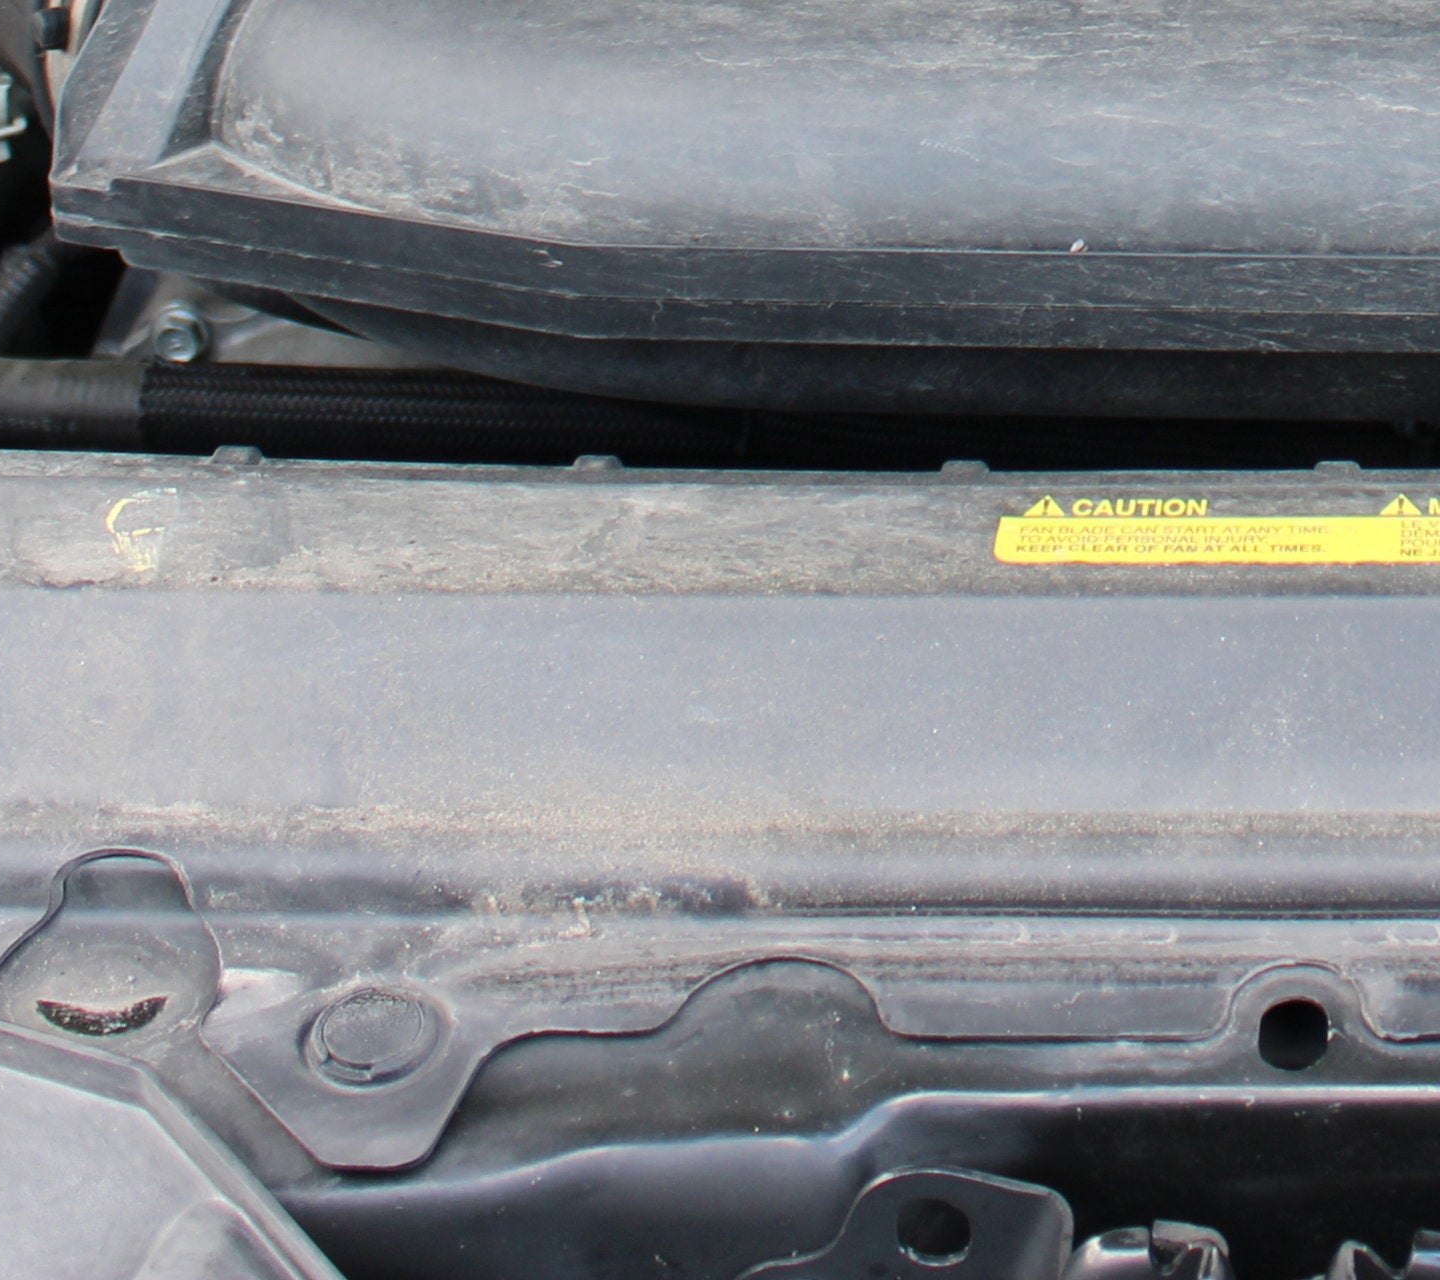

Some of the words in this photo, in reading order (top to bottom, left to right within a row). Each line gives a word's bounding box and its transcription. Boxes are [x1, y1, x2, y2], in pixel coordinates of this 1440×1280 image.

[1071, 498, 1208, 517] CAUTION
[1400, 519, 1421, 529] LE
[1020, 525, 1051, 535] FAN
[1058, 525, 1111, 535] BLADE
[1123, 525, 1156, 535] CAN
[1162, 525, 1219, 535] START
[1223, 525, 1242, 535] AT
[1248, 525, 1281, 535] ANY
[1020, 535, 1041, 544] TO
[1046, 535, 1098, 544] AVOID
[1103, 535, 1197, 544] PERSONAL
[1016, 544, 1063, 553] KEEP
[1068, 544, 1127, 553] CLEAR
[1134, 544, 1158, 553] OF
[1163, 544, 1198, 553] FAN
[1204, 544, 1224, 553] AT
[1230, 544, 1259, 553] ALL
[1400, 547, 1421, 556] NE
